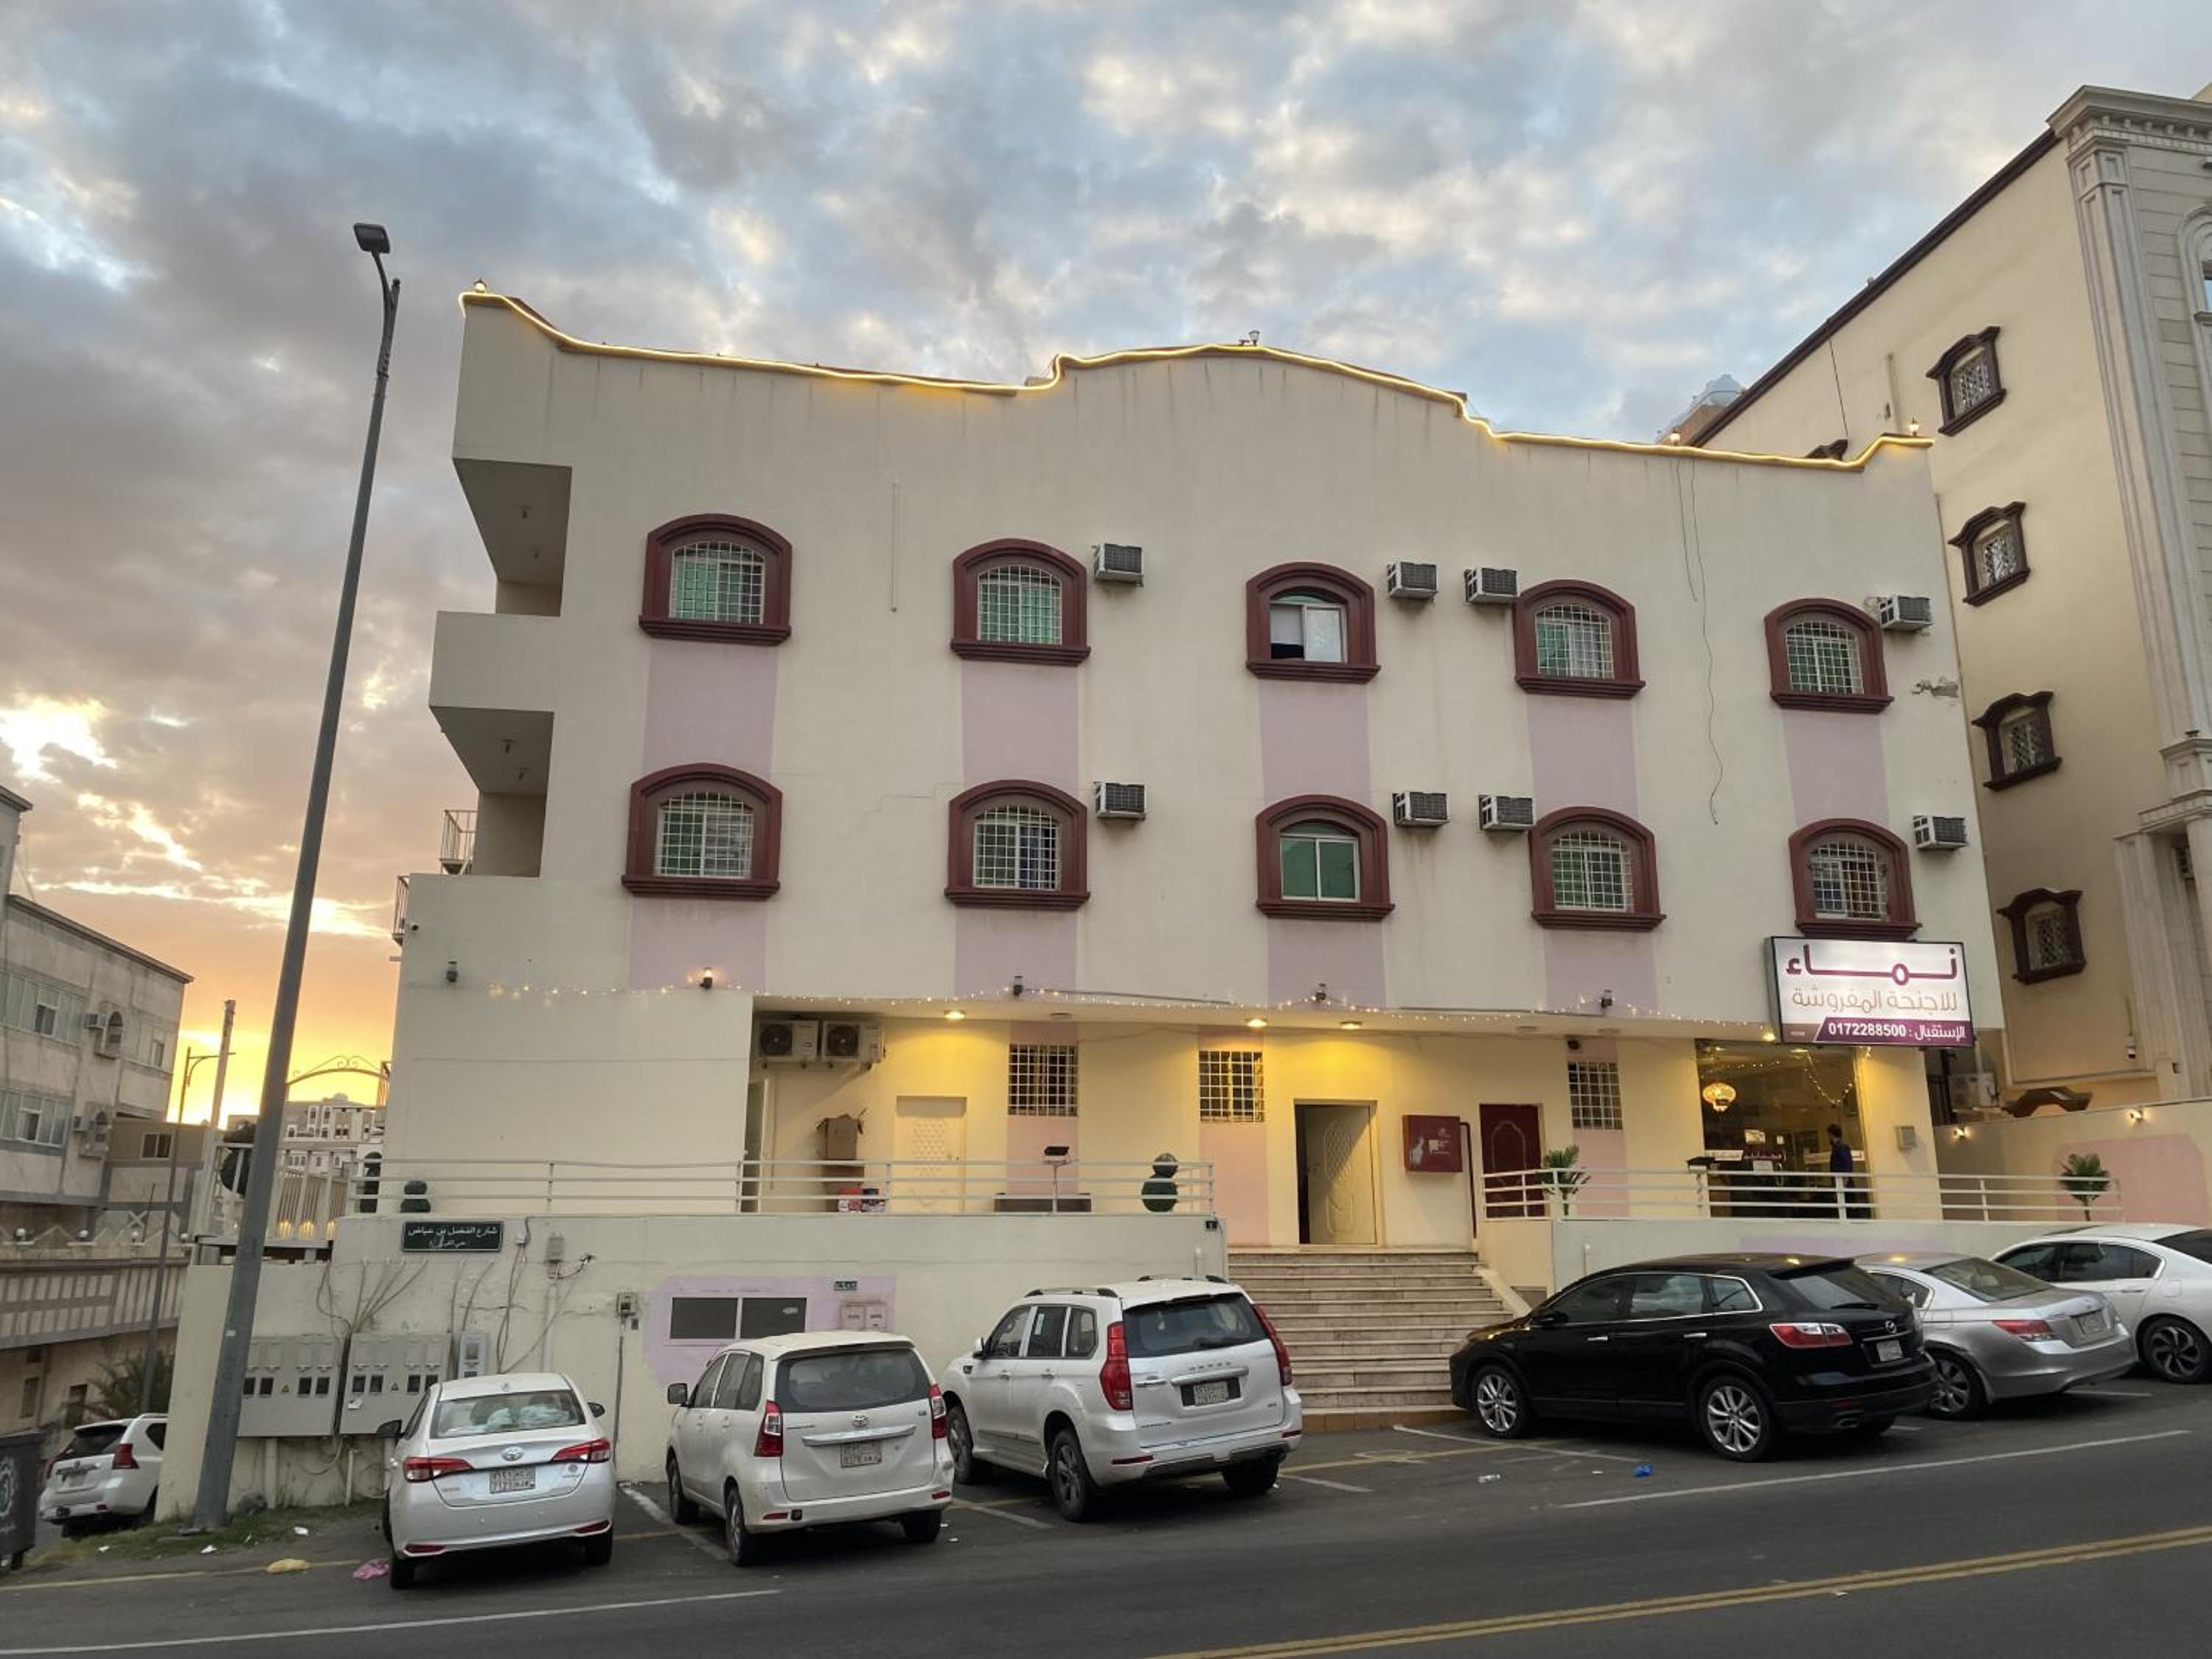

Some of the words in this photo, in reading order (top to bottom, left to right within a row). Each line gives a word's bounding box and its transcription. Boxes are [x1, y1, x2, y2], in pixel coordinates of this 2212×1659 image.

[1786, 944, 1958, 986] نماء
[1792, 984, 1882, 1013] المفروشة
[1828, 1022, 1906, 1037] 0172288500
[436, 1227, 446, 1237] بن
[476, 1226, 498, 1238] شارع
